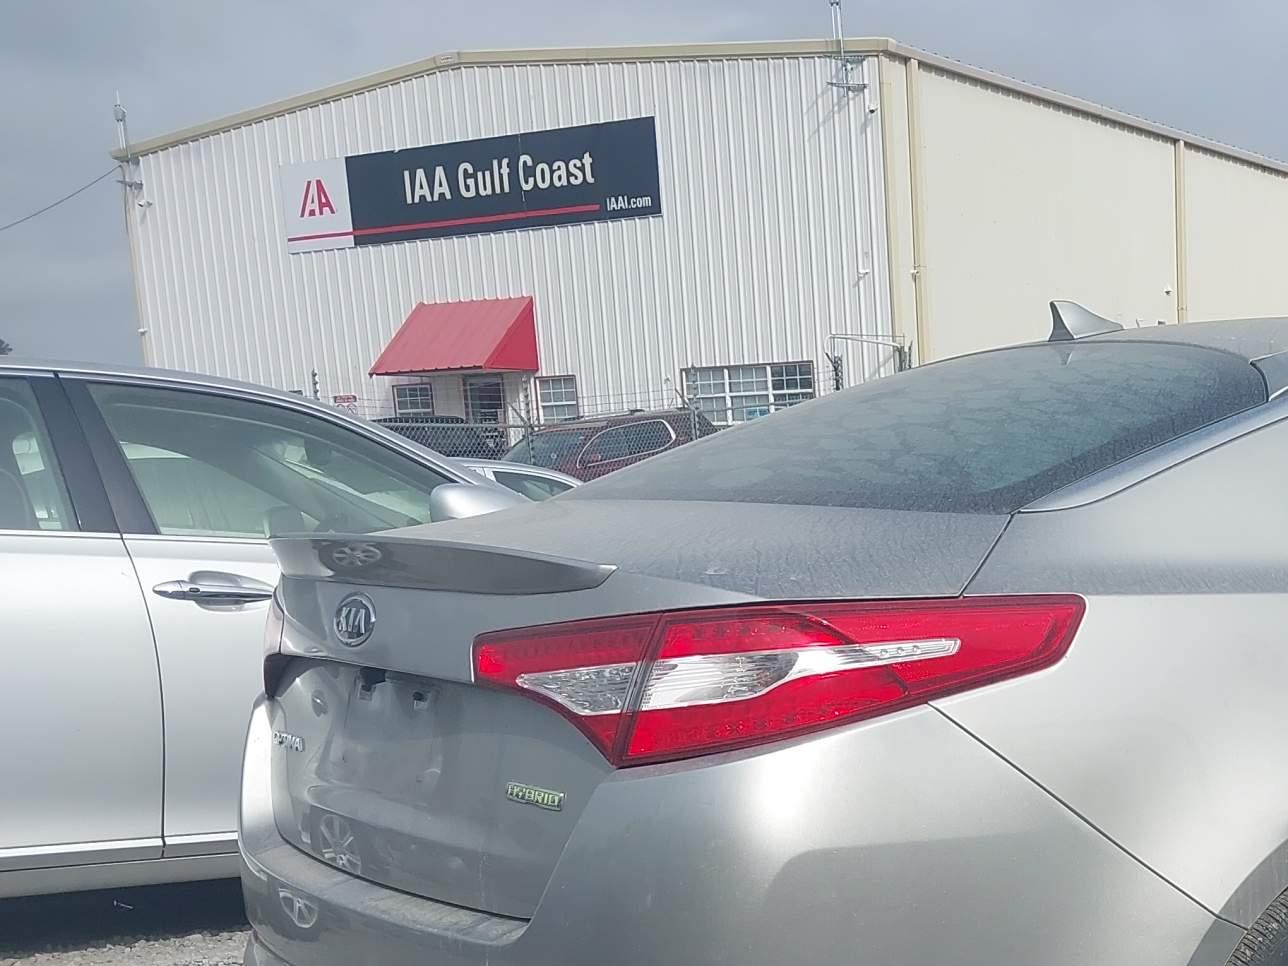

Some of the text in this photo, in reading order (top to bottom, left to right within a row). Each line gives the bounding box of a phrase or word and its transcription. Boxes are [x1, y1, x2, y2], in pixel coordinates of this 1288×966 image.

[404, 152, 594, 204] IAA Gulf Coast
[606, 195, 652, 211] IAAI.com
[338, 607, 366, 634] KIA
[507, 783, 560, 808] HYBRID
